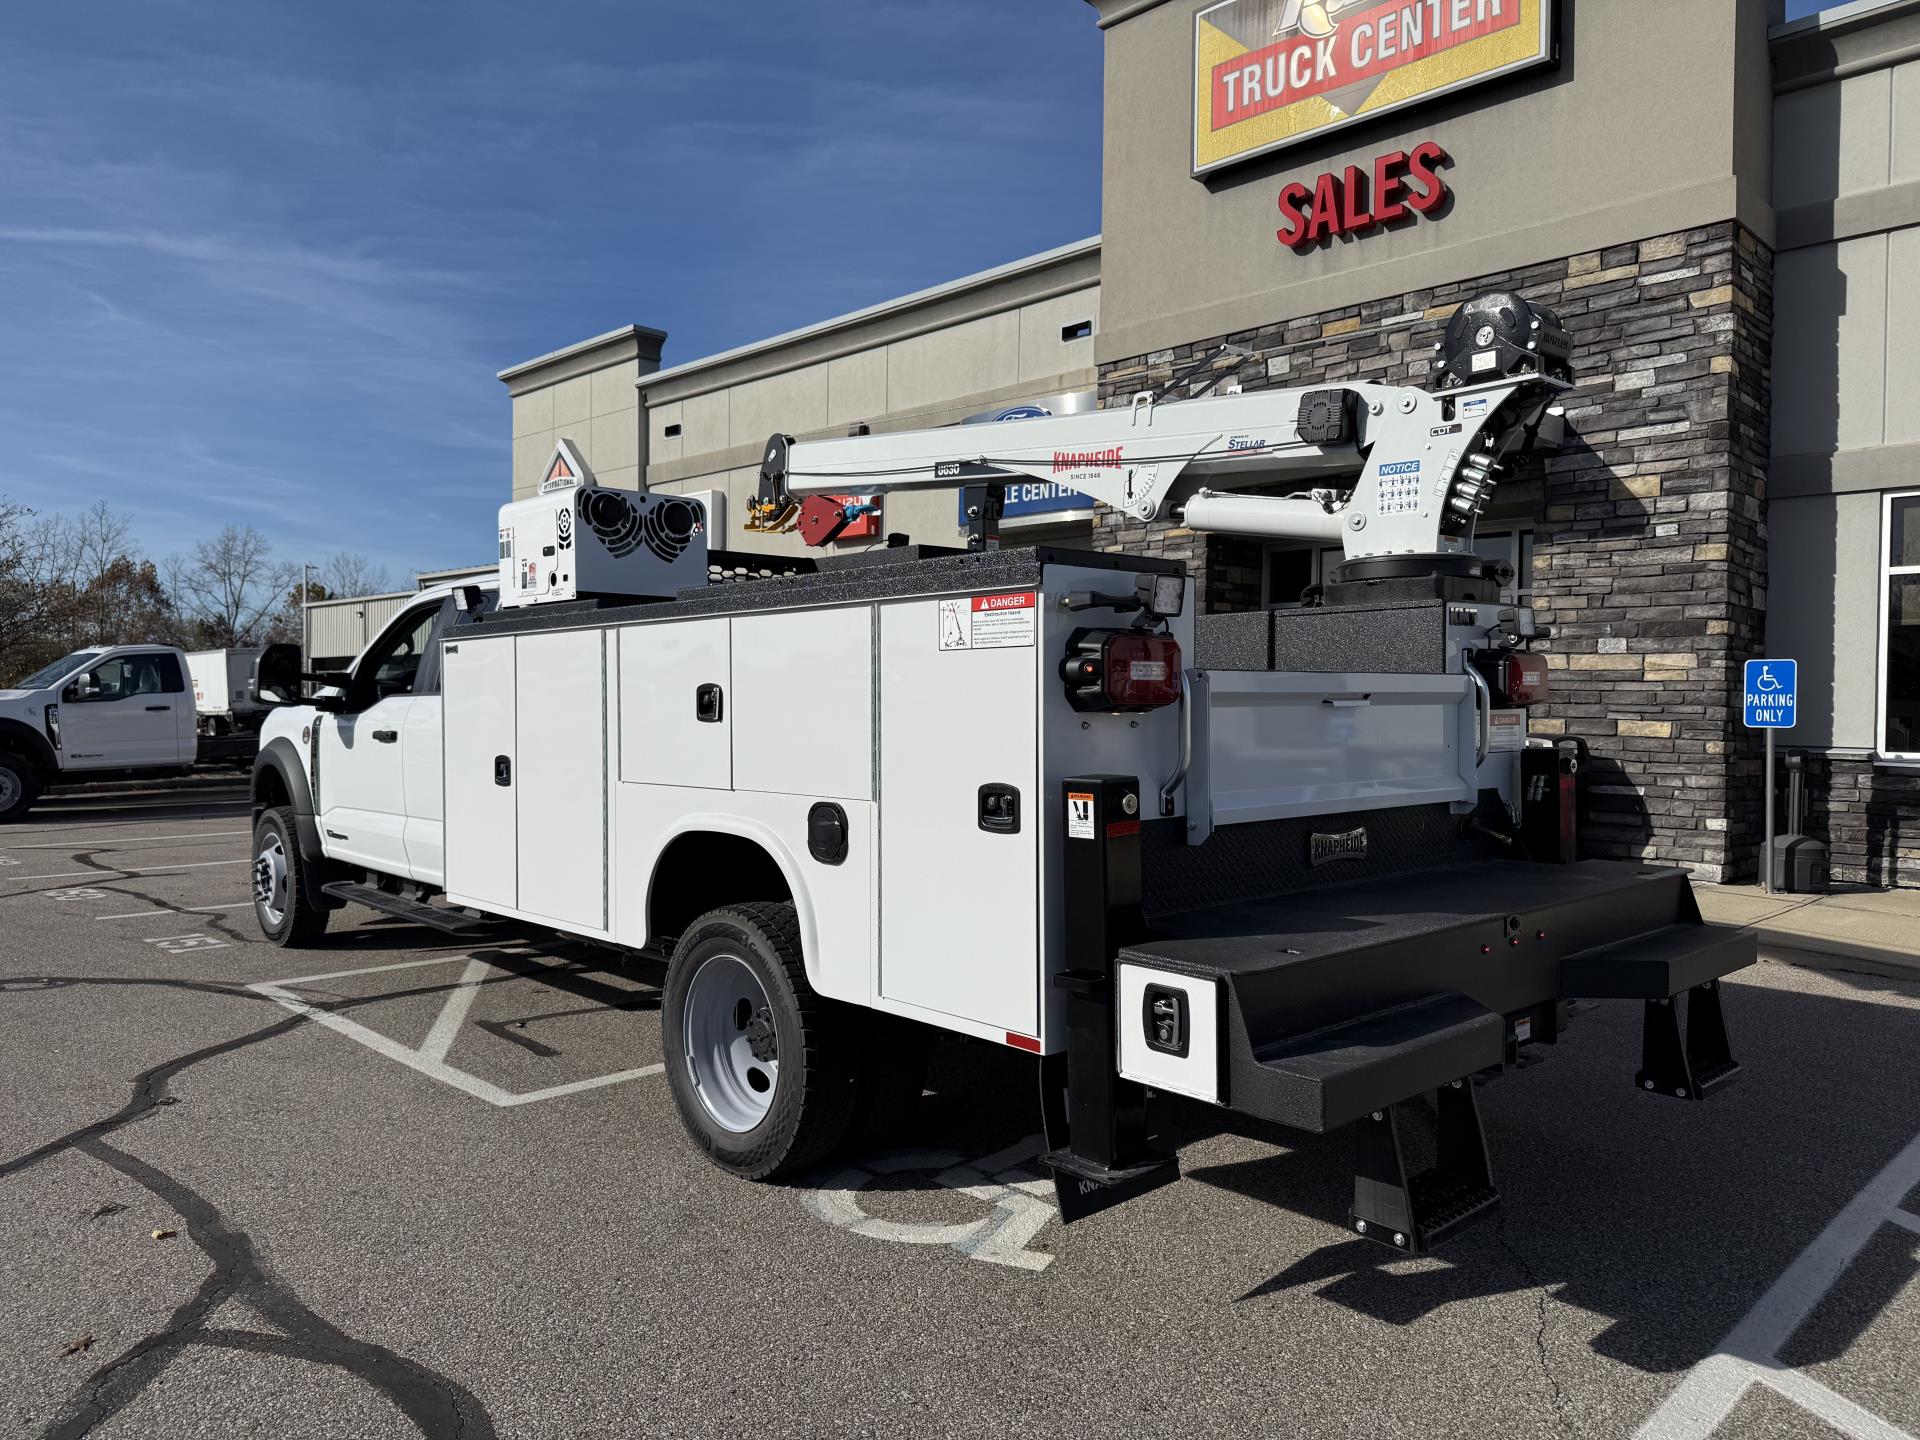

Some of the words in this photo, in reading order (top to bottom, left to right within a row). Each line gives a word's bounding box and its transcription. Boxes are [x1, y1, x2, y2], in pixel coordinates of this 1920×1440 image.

[1222, 35, 1338, 113] TRUCK
[1276, 141, 1450, 248] SALES
[1052, 445, 1124, 474] KNAPHEIDE
[1380, 462, 1419, 475] NOTICE
[990, 596, 1025, 608] DANGER
[1450, 607, 1478, 626] KMT
[1747, 693, 1793, 707] PARKING
[1755, 709, 1784, 722] ONLY
[1314, 833, 1366, 861] KNAPHEIDE
